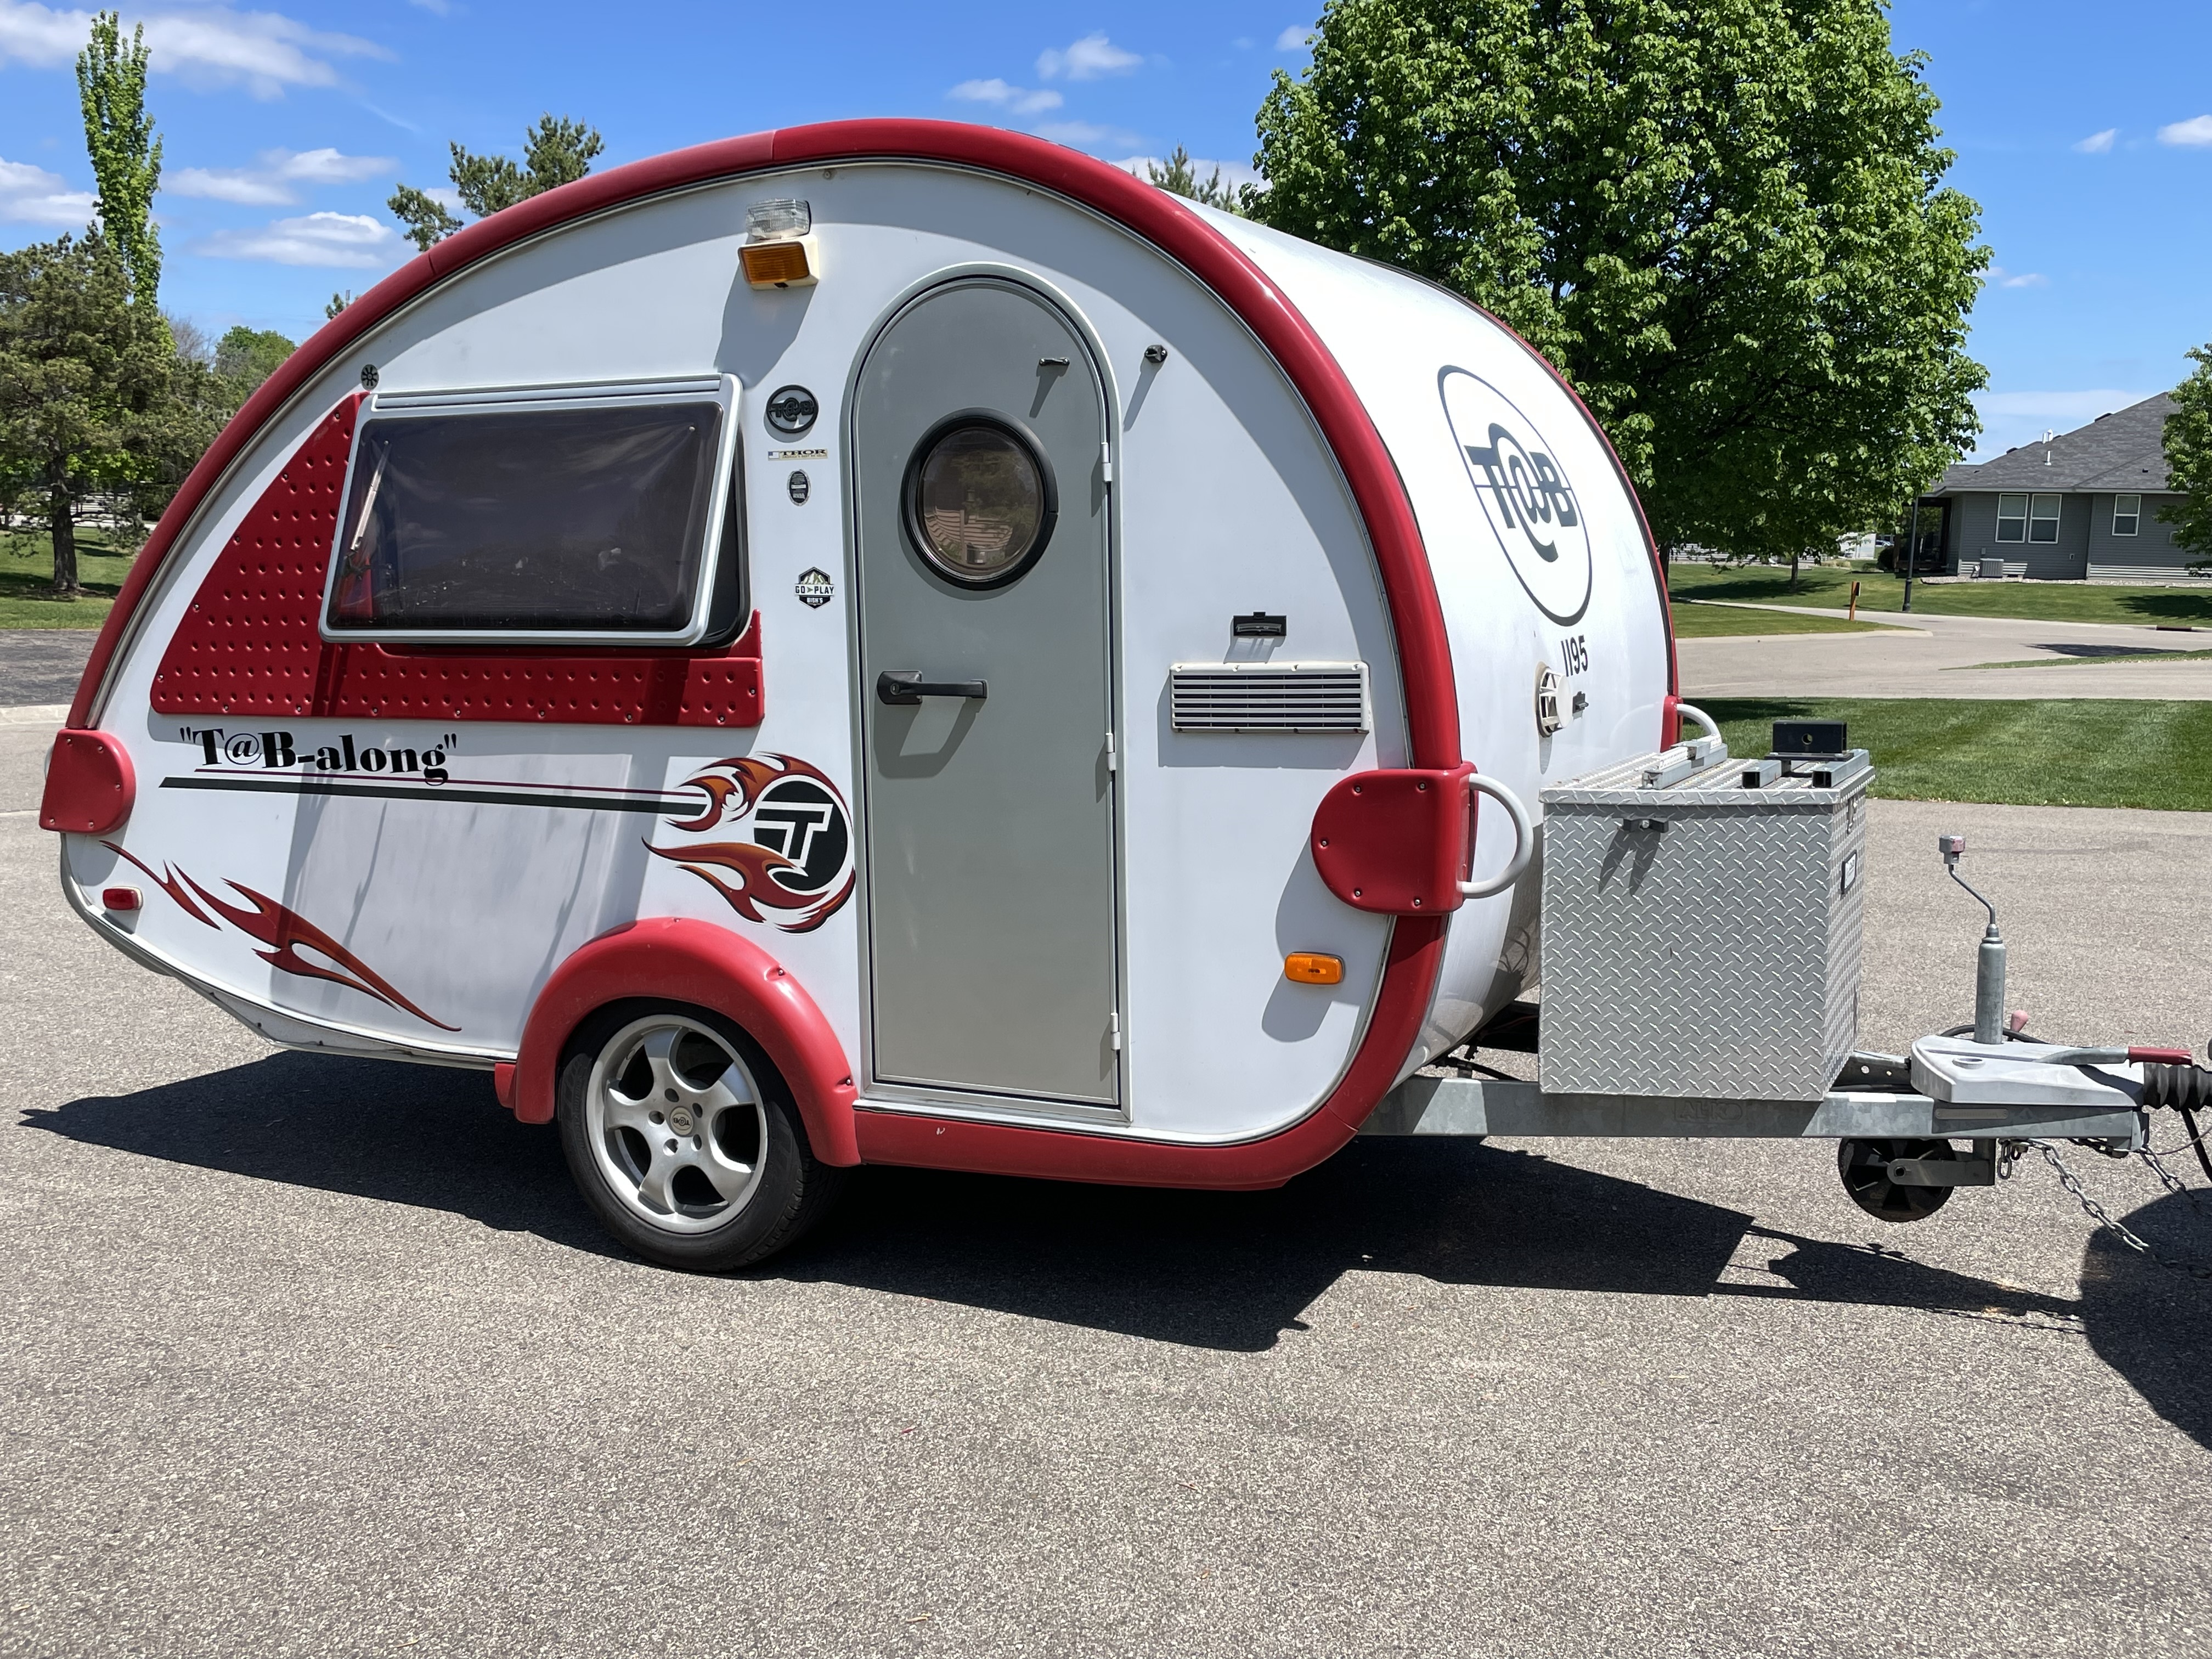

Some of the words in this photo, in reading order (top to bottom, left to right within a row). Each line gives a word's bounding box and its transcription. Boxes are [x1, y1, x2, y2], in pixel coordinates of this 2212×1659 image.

[768, 397, 815, 422] T@B
[1463, 422, 1578, 563] T@B
[795, 585, 805, 594] GO
[814, 586, 834, 594] PLAY
[1560, 634, 1588, 677] 1195
